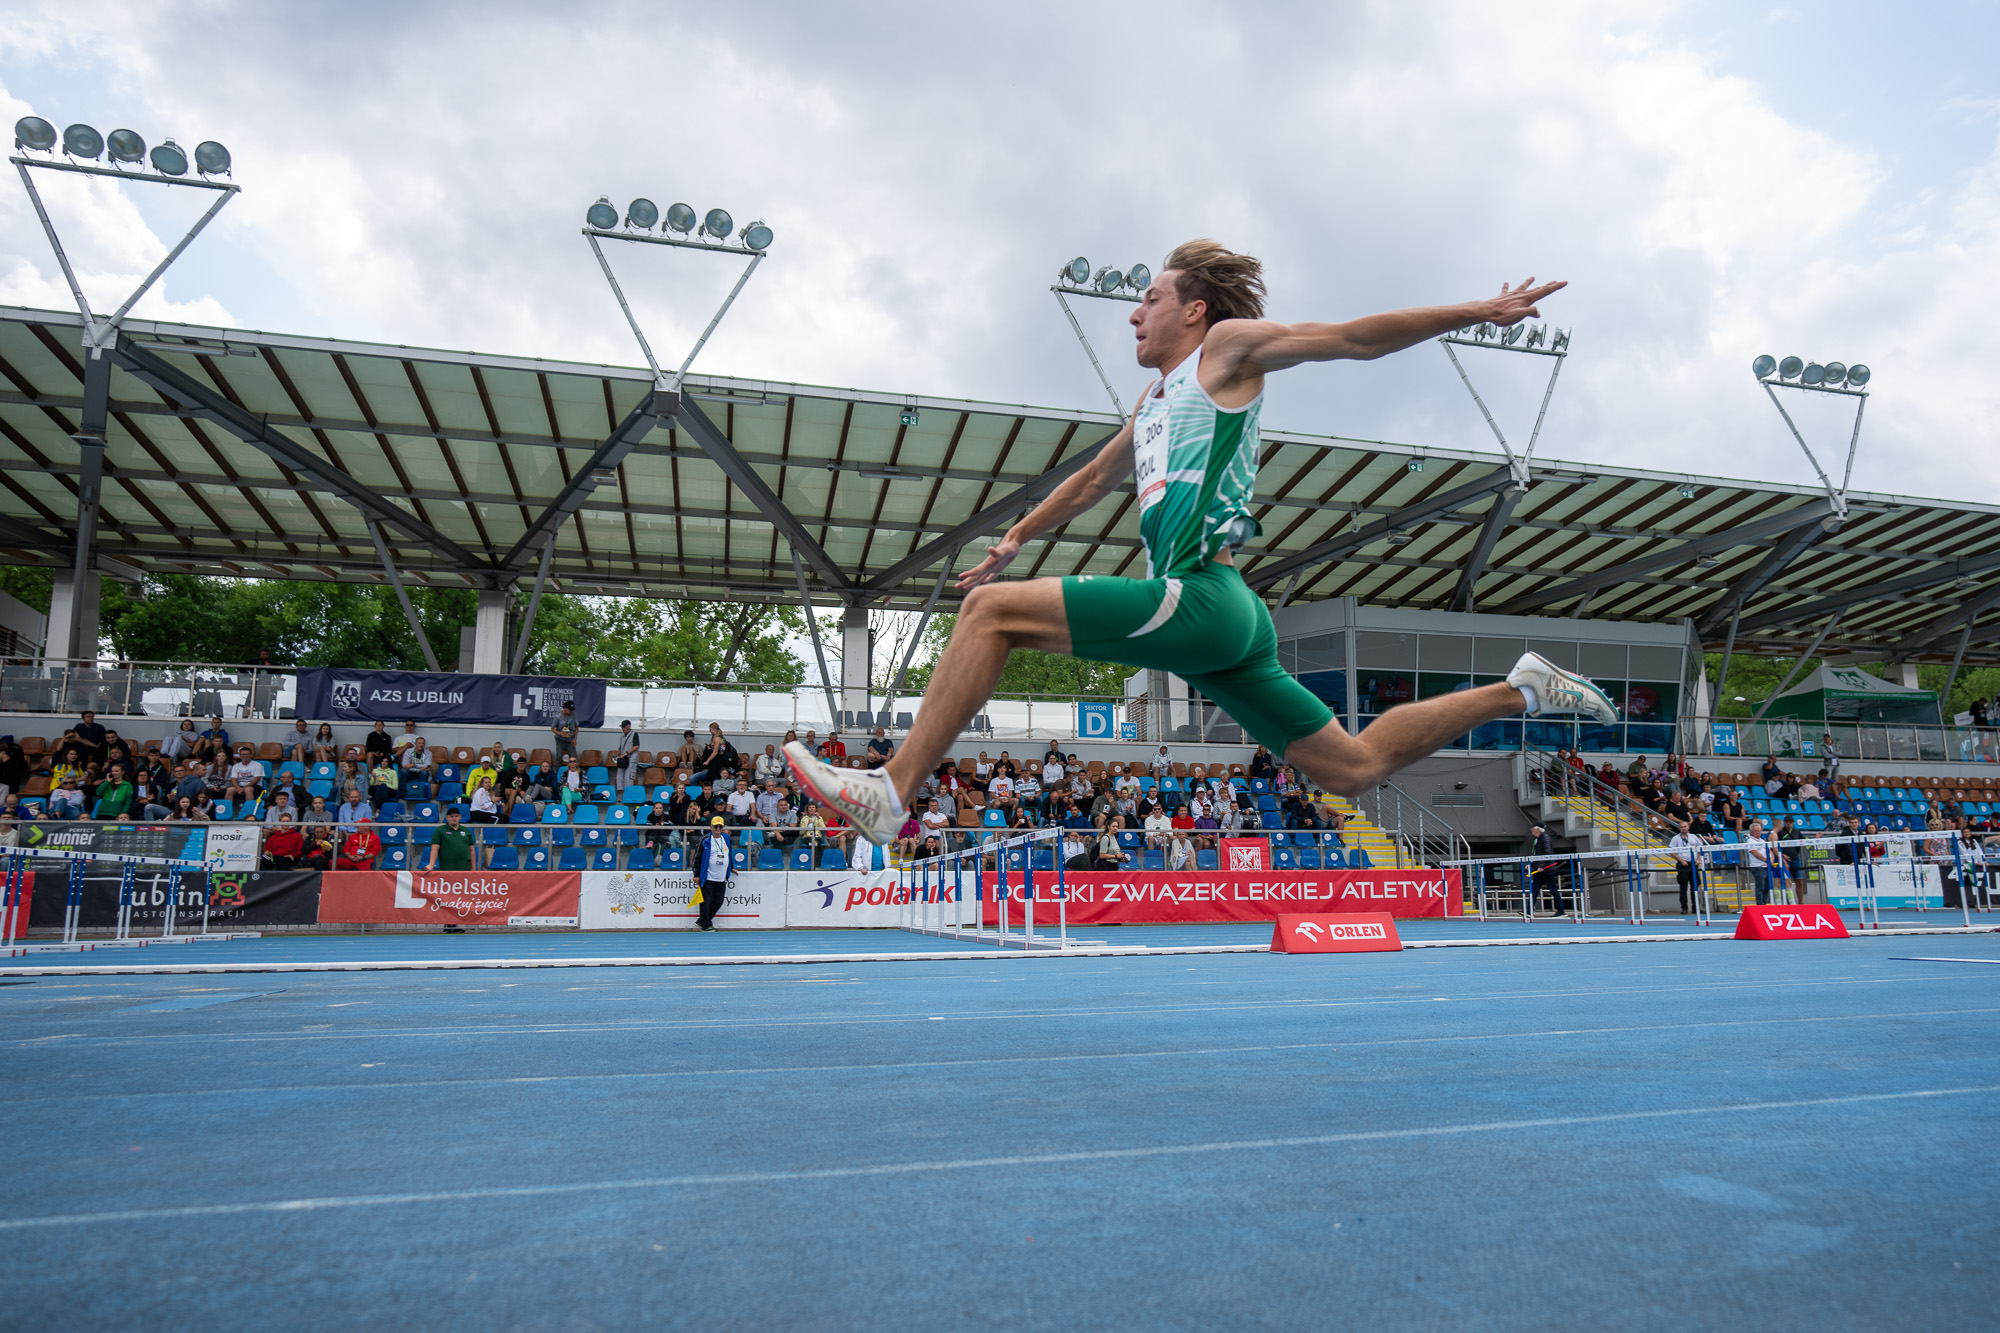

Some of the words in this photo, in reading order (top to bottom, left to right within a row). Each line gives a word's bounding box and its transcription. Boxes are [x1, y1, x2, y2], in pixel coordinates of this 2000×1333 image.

[1146, 418, 1162, 444] 206
[370, 690, 402, 701] AZS
[407, 691, 463, 703] LUBLIN
[1086, 712, 1106, 735] D
[1713, 734, 1735, 747] E-H
[46, 833, 96, 845] runner
[211, 832, 242, 841] mosir
[1810, 850, 1828, 858] team
[420, 877, 508, 895] lubelskie
[654, 878, 735, 889] Ministeo
[844, 881, 956, 912] polanik
[992, 884, 1094, 903] POLSKI
[1103, 883, 1227, 905] ZWIĄZEK
[1235, 882, 1333, 900] LEKKIEJ
[1341, 880, 1448, 899] ATLETYKI
[431, 897, 475, 917] Smakuj
[474, 898, 509, 915] życie!
[1763, 913, 1835, 931] PZLA
[1334, 925, 1382, 938] ORLEN
